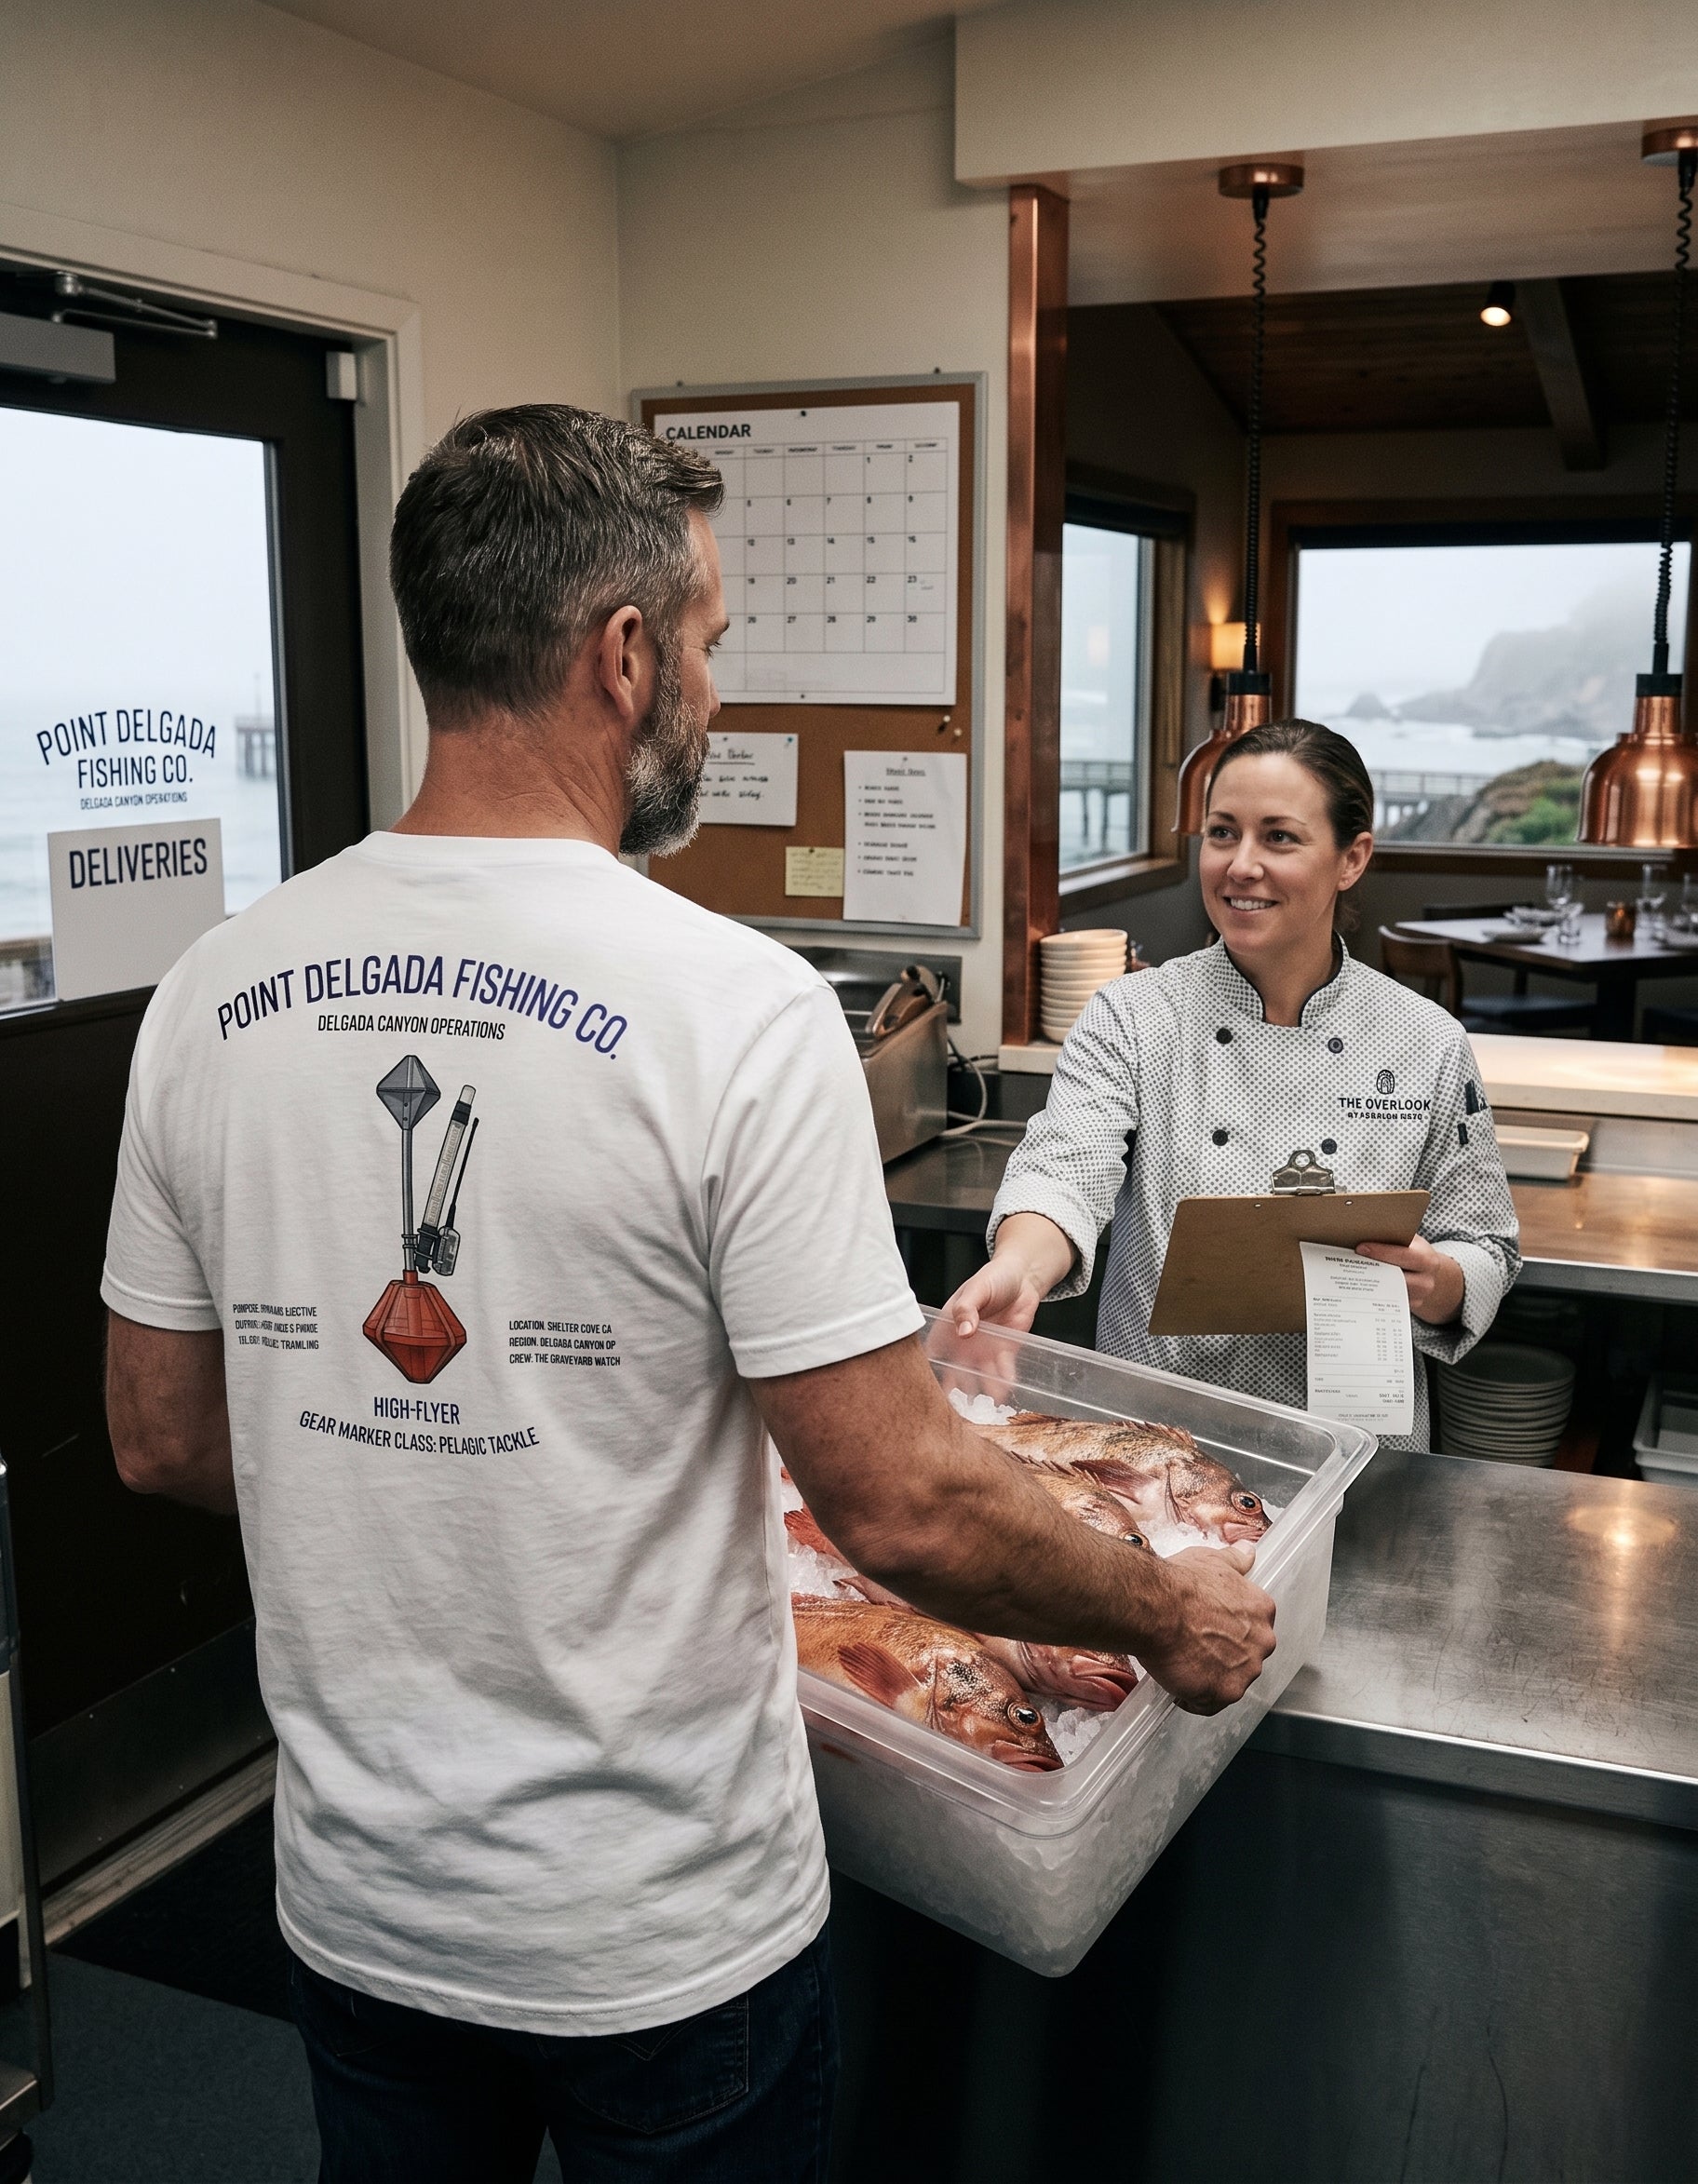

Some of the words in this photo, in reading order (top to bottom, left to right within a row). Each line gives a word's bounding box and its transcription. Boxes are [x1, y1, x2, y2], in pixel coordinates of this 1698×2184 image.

[666, 424, 751, 440] CALENDAR
[826, 496, 831, 505] 7
[786, 576, 797, 585] 20
[866, 575, 877, 584] 22
[907, 575, 918, 584] 23
[787, 615, 797, 624] 27
[36, 710, 108, 766] POINT
[115, 708, 216, 759] DELGADA
[77, 755, 156, 789] FISHING
[162, 754, 194, 784] CO.
[69, 837, 208, 890] DELIVERIES
[217, 969, 295, 1042] POINT
[304, 954, 443, 1004] DELGADA
[452, 958, 579, 1030] FISHING
[574, 1003, 628, 1060] CO.
[317, 1014, 374, 1032] DELGADA
[377, 1014, 428, 1034] CANYON
[430, 1017, 506, 1041] OPERATIONS
[1338, 1098, 1362, 1109] THE
[1366, 1099, 1432, 1111] OVERLOOK
[547, 1321, 579, 1333] SHELTER
[580, 1324, 600, 1334] COVE
[601, 1324, 613, 1334] CA
[605, 1341, 616, 1350] OP
[534, 1353, 548, 1364] THE
[594, 1356, 621, 1367] WATCH
[373, 1395, 461, 1425] HIGH-FLYER
[299, 1409, 337, 1436] GEAR
[337, 1421, 392, 1449] MARKER
[394, 1431, 438, 1454] CLASS:
[438, 1436, 488, 1456] PELAGIC
[487, 1426, 541, 1455] TACKLE
